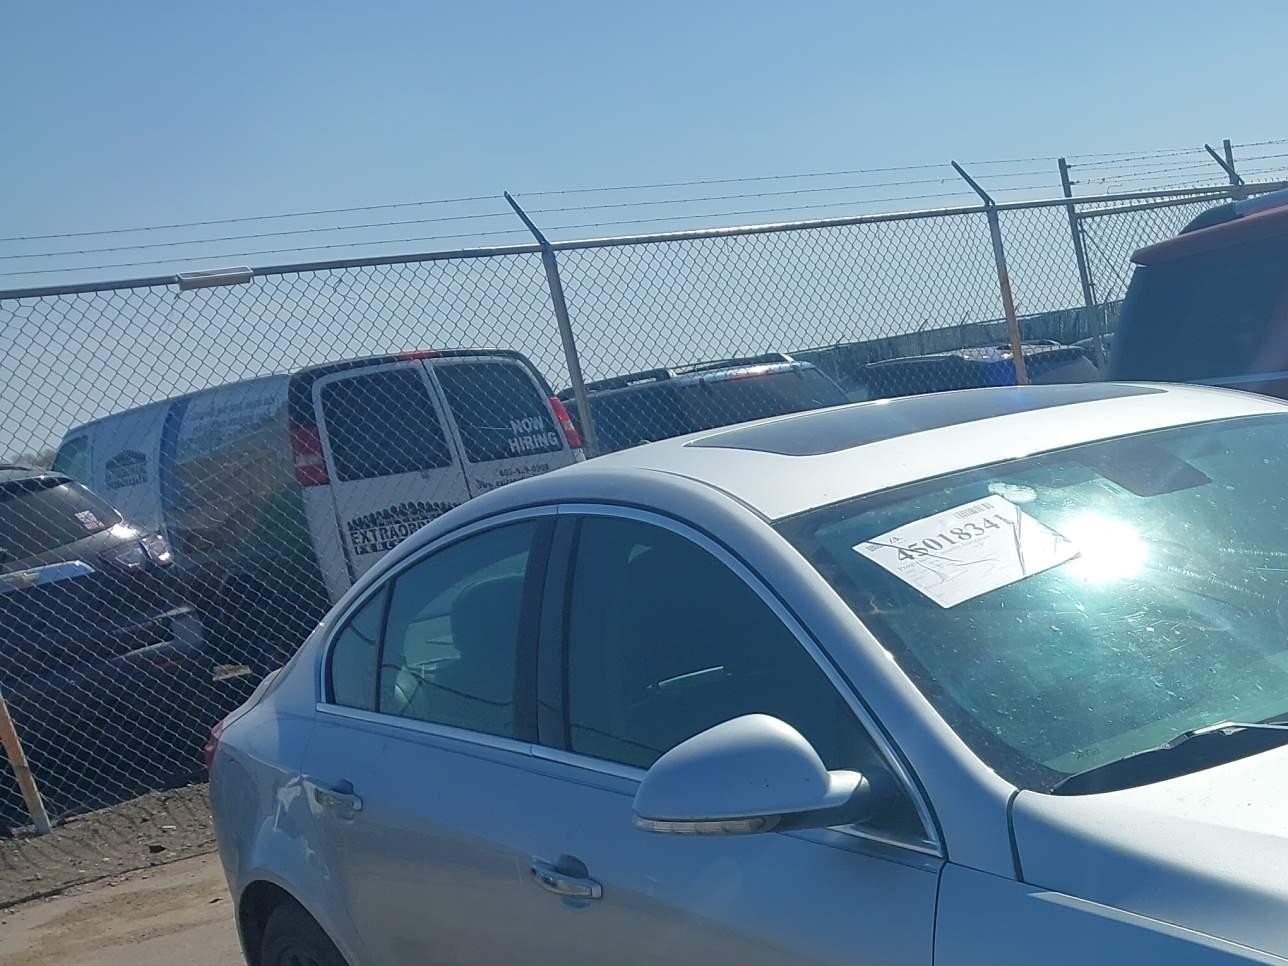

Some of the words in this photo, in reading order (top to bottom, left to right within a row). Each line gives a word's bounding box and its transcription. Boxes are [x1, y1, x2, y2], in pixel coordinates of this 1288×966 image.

[510, 416, 544, 435] NOW
[508, 431, 559, 454] HIRING
[351, 519, 432, 545] EXTRAORD
[897, 513, 1015, 562] 45018341
